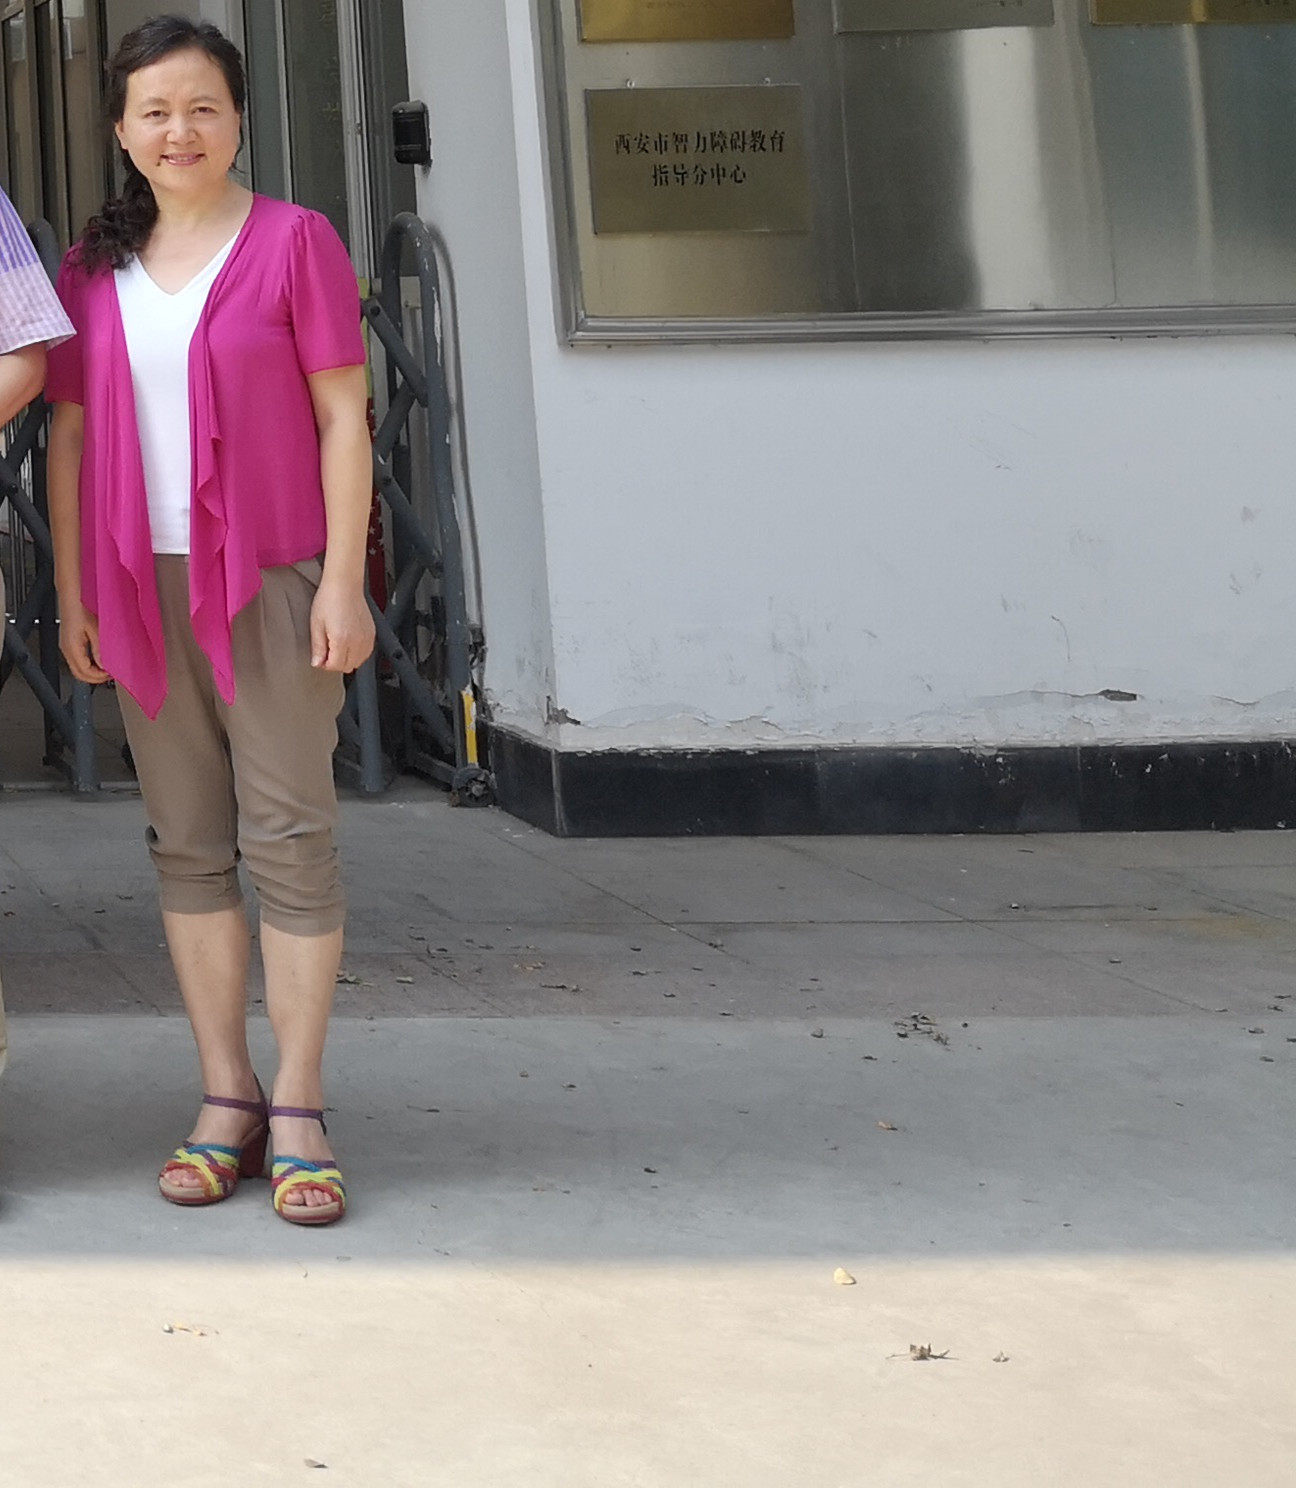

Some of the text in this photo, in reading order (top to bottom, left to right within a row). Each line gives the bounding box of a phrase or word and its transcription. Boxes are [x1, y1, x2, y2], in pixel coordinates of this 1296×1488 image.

[614, 128, 787, 156] 西安市智力障碍教育
[651, 162, 747, 187] 指导分中心
